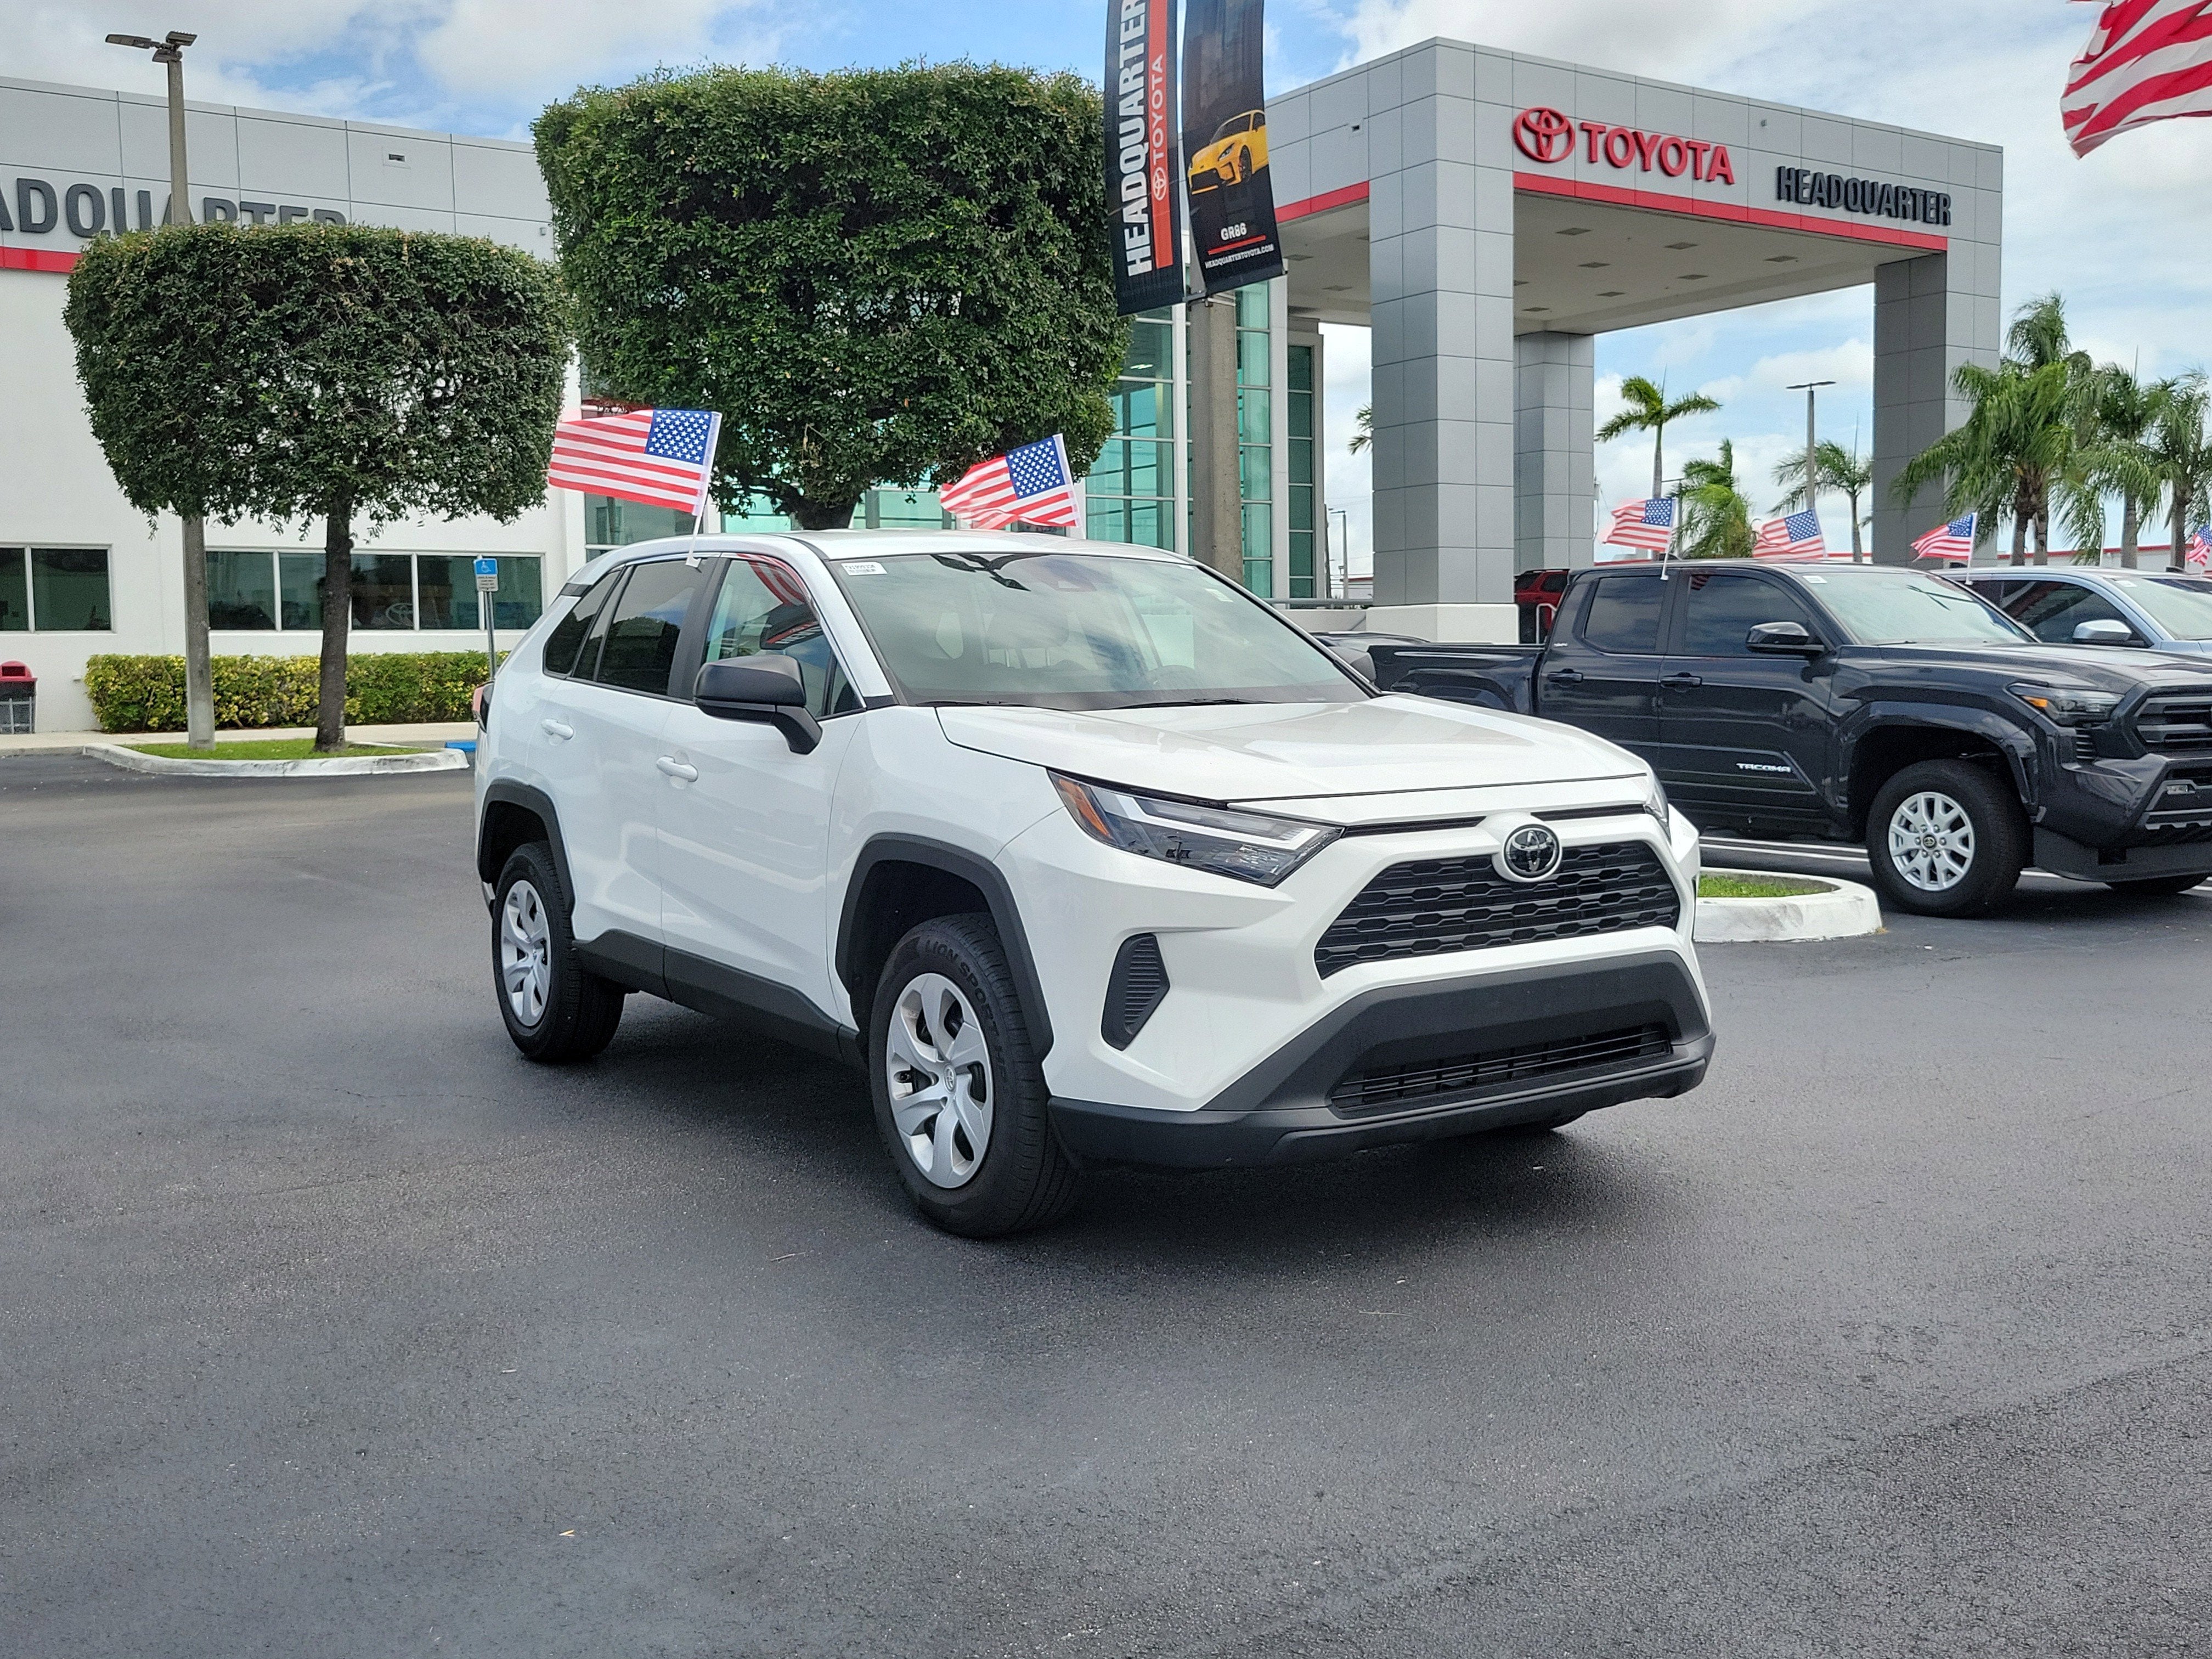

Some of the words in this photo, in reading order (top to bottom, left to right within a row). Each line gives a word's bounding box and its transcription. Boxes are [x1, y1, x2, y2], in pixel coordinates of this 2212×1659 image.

[1119, 0, 1153, 277] HEADQUARTER
[1151, 54, 1164, 168] TOYOTA
[1580, 122, 1735, 185] TOYOTA
[1776, 166, 1951, 226] HEADQUARTER
[1220, 222, 1248, 241] GR86
[1736, 763, 1791, 773] TACOMA
[925, 939, 959, 961] LION
[958, 961, 1000, 1037] SPORT
